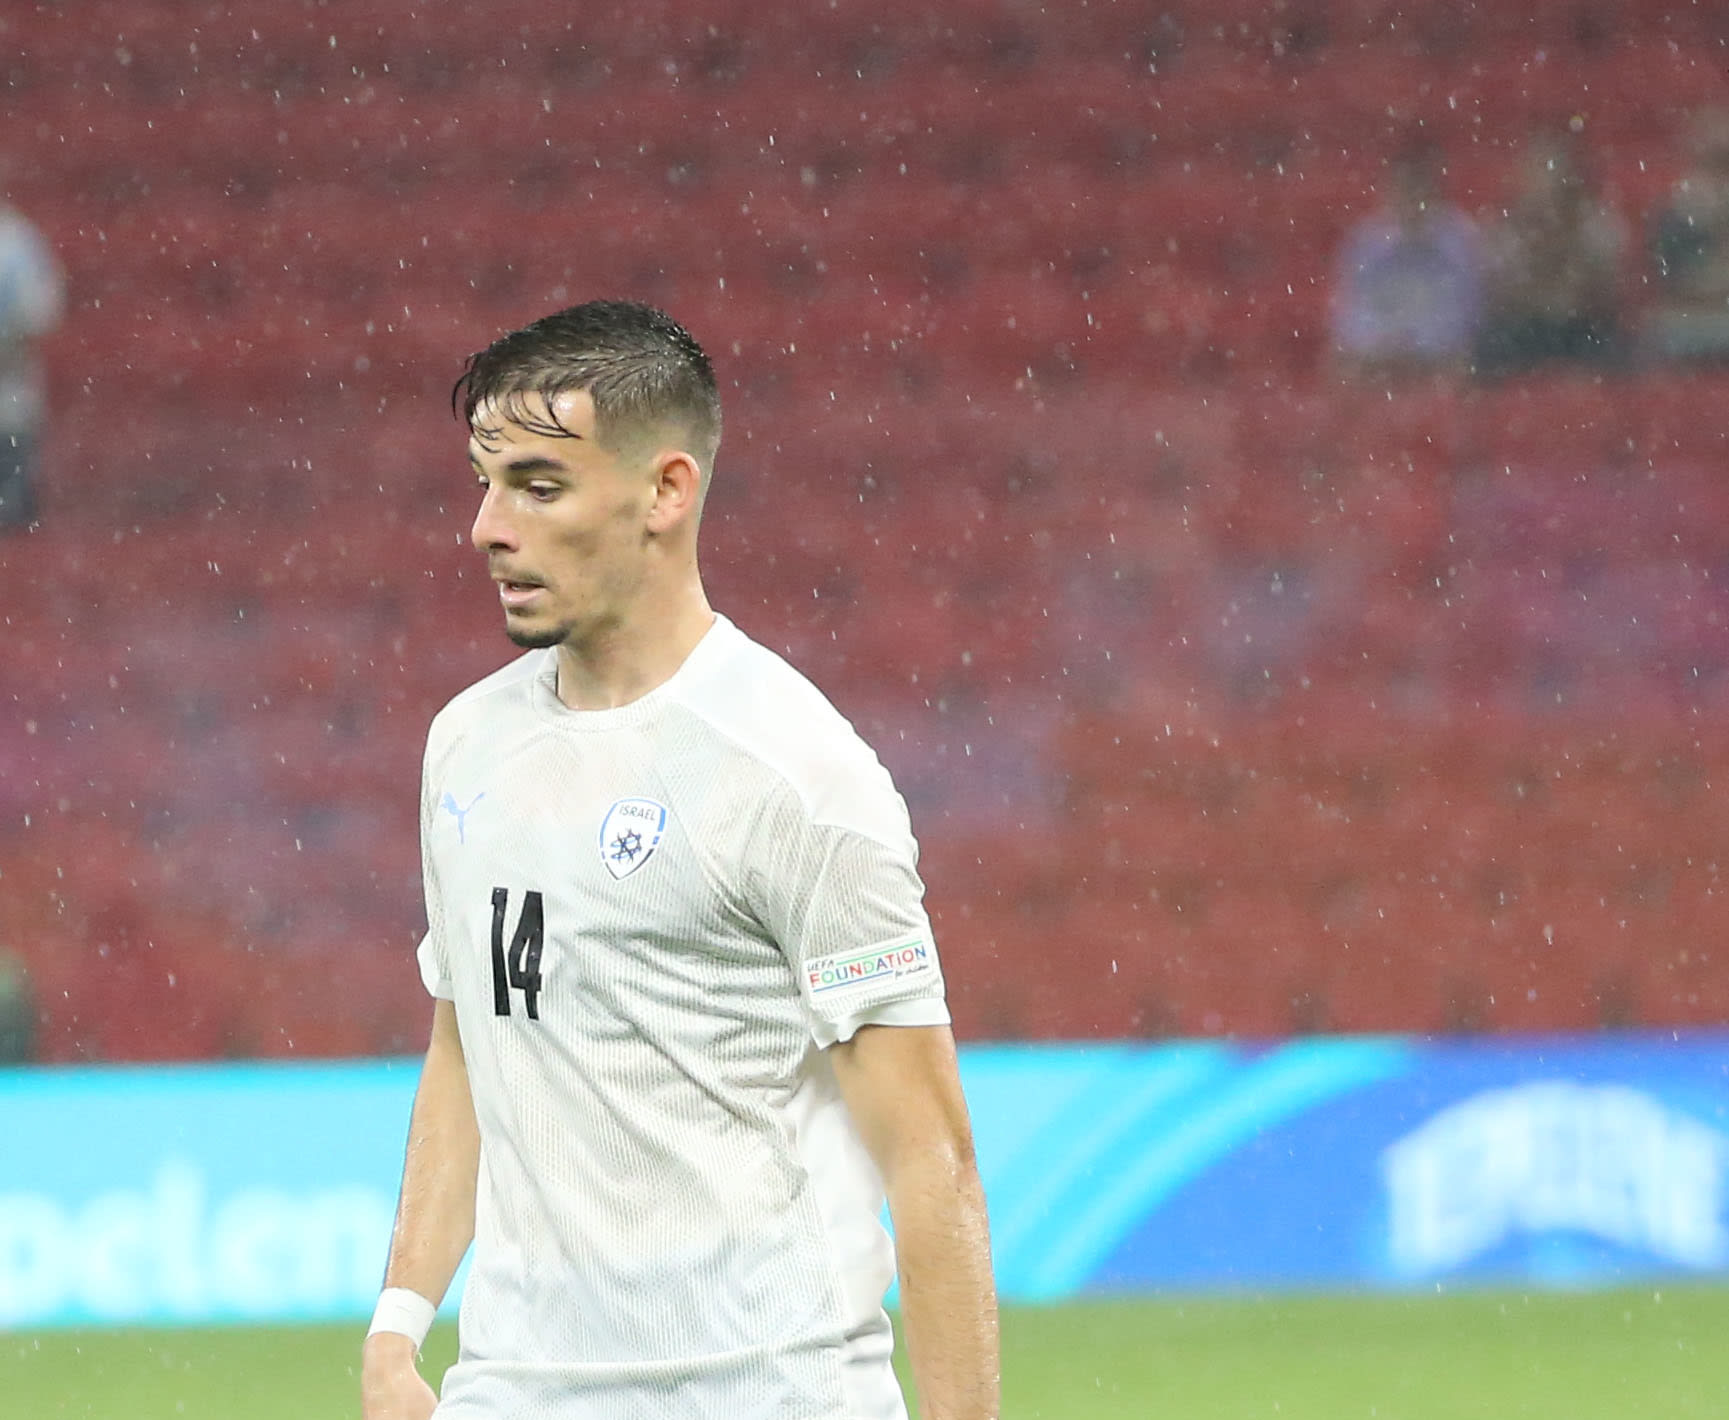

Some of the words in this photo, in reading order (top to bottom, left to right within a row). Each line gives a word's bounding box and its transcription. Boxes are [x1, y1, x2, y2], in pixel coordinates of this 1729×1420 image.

[619, 804, 656, 821] ISRAEL
[490, 886, 545, 1021] 14
[807, 958, 834, 972] UEFA
[809, 945, 927, 988] FOUNDATION
